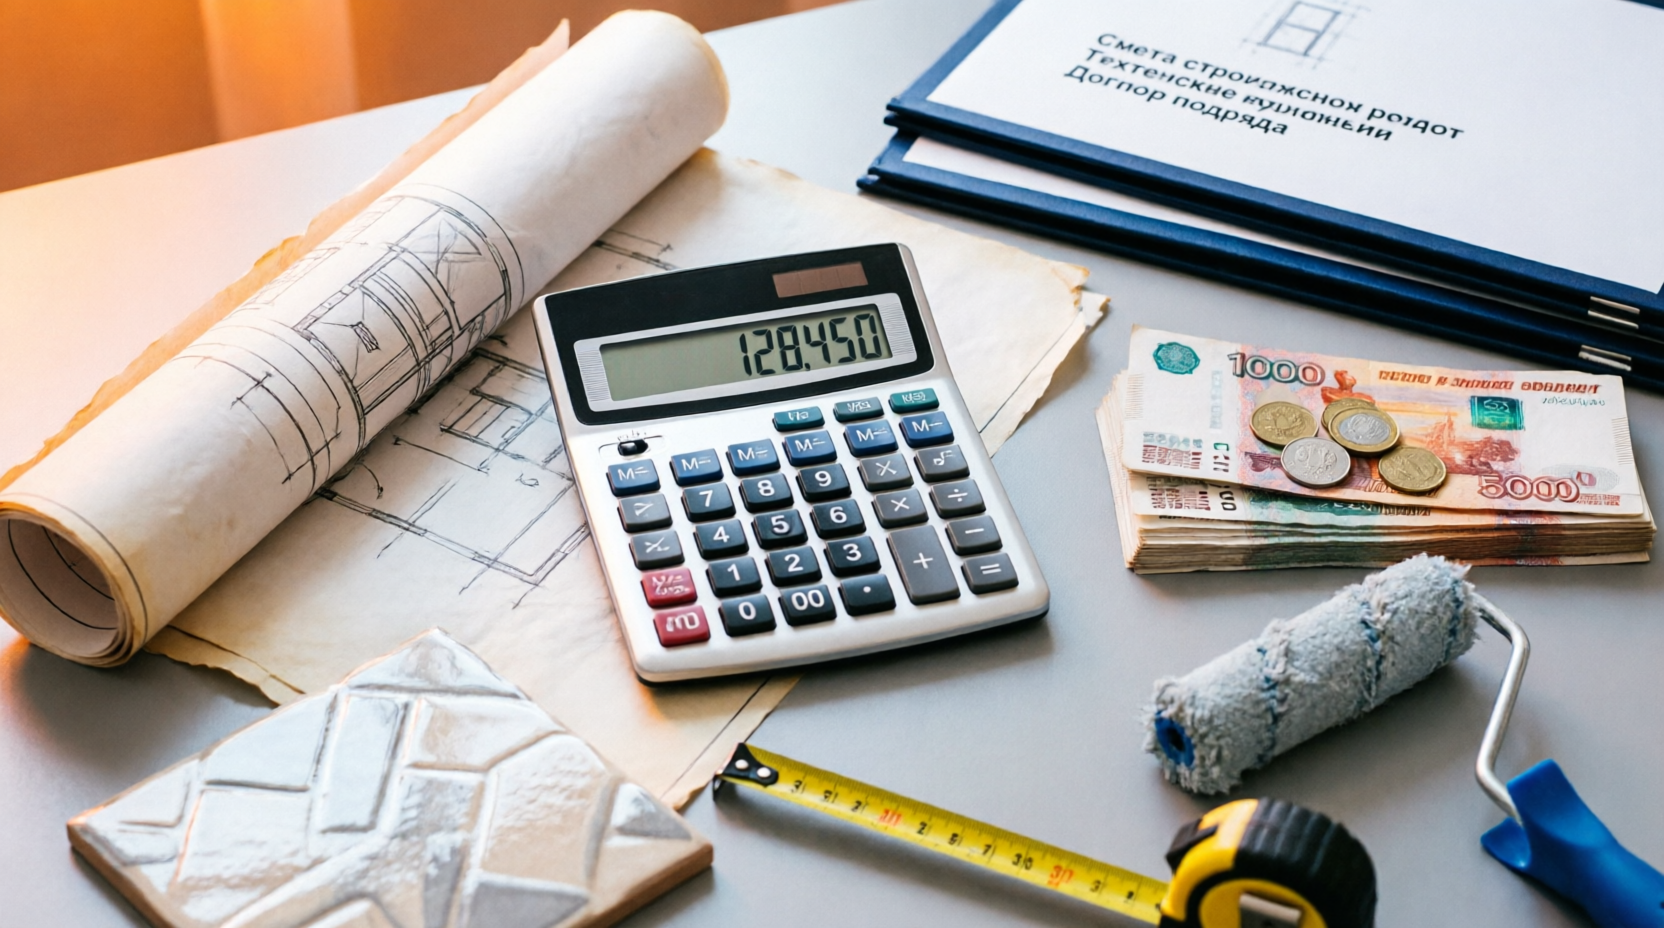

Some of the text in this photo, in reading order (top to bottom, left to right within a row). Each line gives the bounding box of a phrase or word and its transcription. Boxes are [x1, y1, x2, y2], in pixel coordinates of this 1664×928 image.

[1097, 33, 1177, 64] Смета
[1172, 95, 1288, 134] подряда
[1228, 352, 1326, 387] 1000
[814, 470, 832, 487] 9
[757, 479, 775, 497] 8
[699, 490, 714, 507] 7
[829, 506, 847, 524] 6
[770, 515, 790, 534] 5
[713, 526, 730, 543] 4
[842, 543, 862, 561] 3
[784, 553, 803, 572] 2
[727, 563, 741, 581] 1
[791, 589, 825, 611] 00
[738, 601, 756, 620] 0
